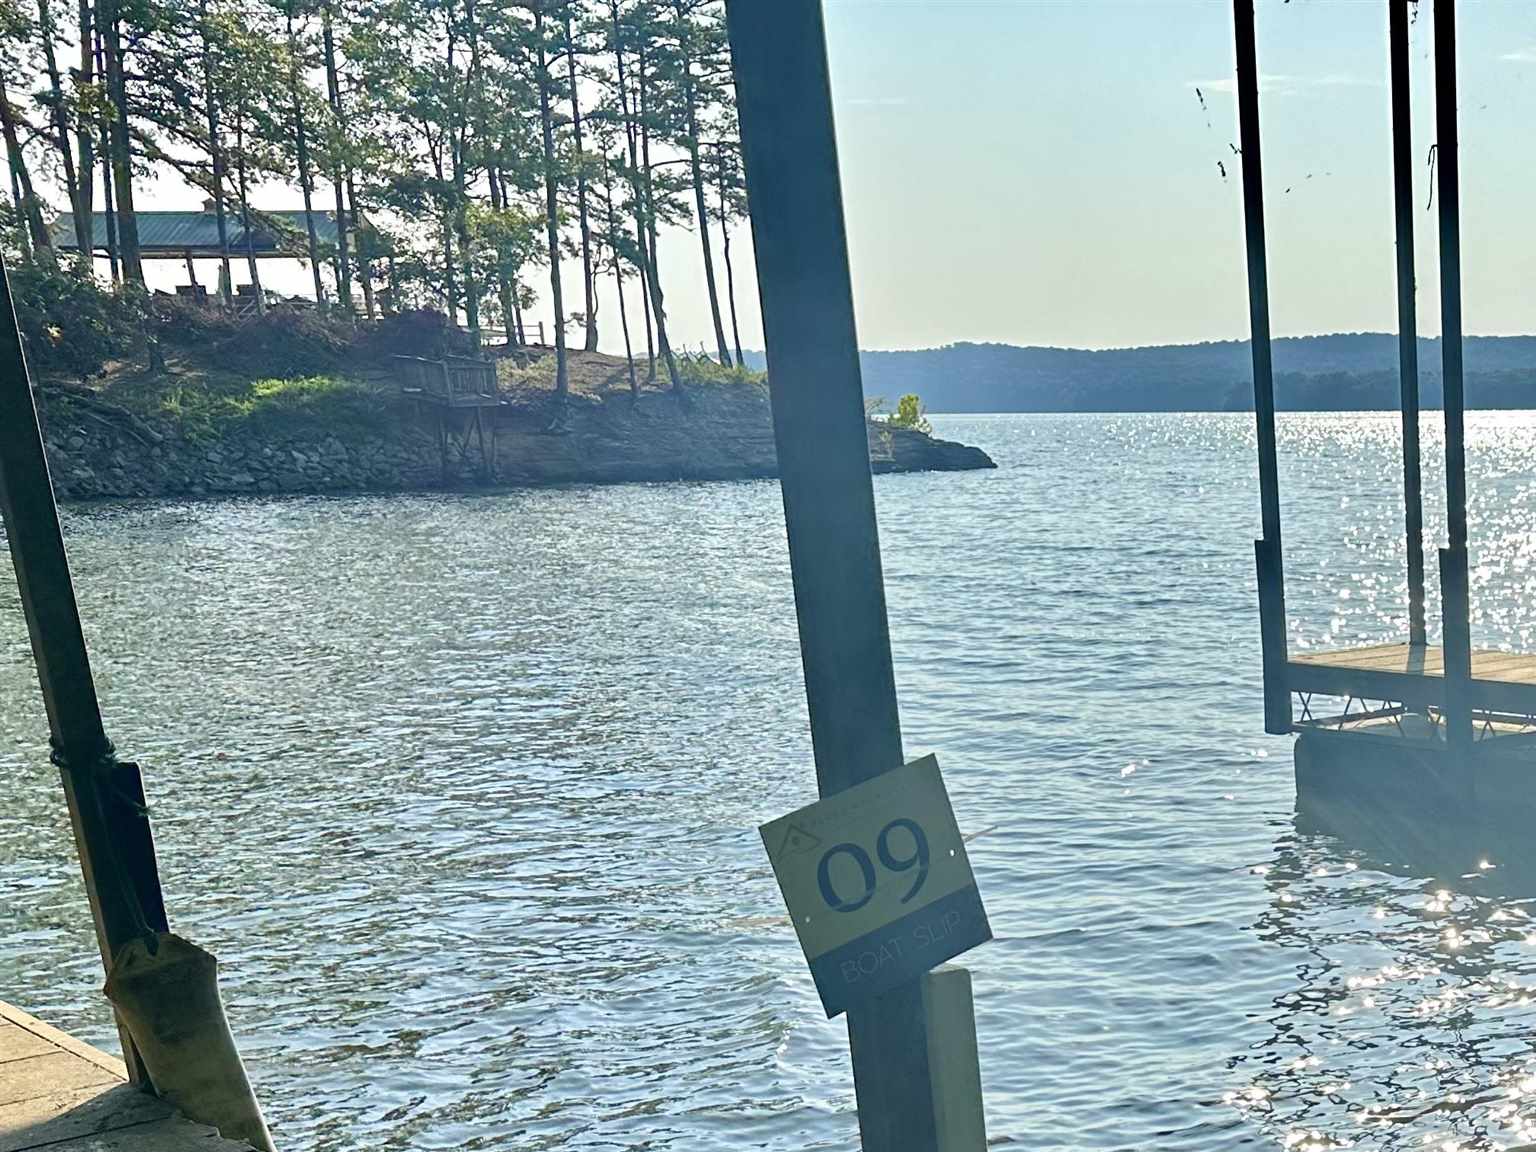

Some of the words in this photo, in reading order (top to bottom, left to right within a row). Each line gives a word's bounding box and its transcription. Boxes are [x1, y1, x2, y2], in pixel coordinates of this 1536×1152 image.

[817, 817, 930, 913] 09
[840, 938, 903, 984] BOAT
[913, 911, 961, 948] SLIP
